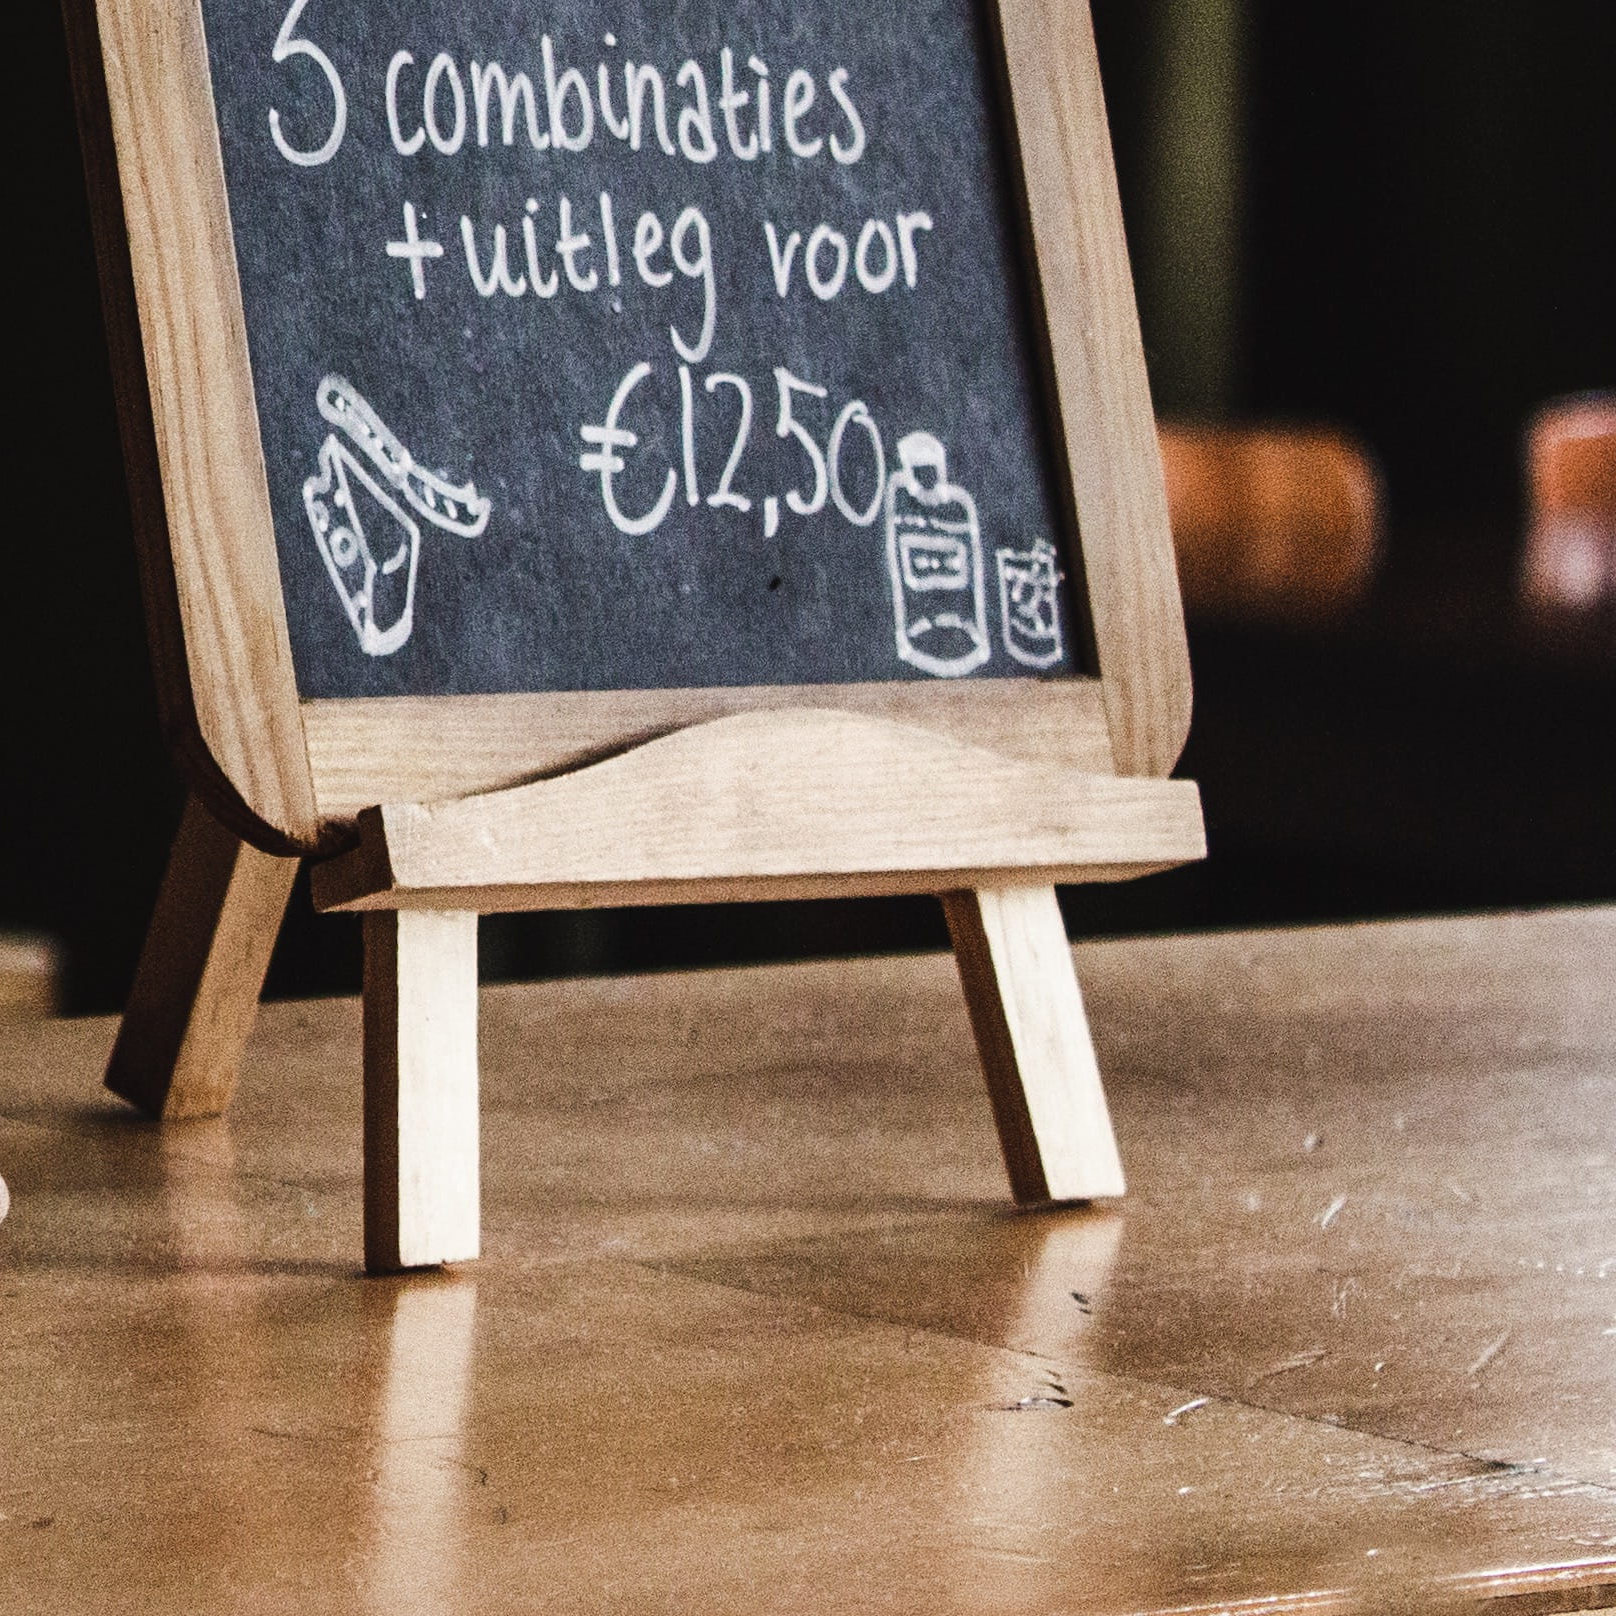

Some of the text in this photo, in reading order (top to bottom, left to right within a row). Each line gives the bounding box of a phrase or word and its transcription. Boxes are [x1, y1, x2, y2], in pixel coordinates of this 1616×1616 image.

[384, 33, 867, 166] combinaties
[764, 209, 934, 301] voor
[578, 361, 886, 538] €12,50
